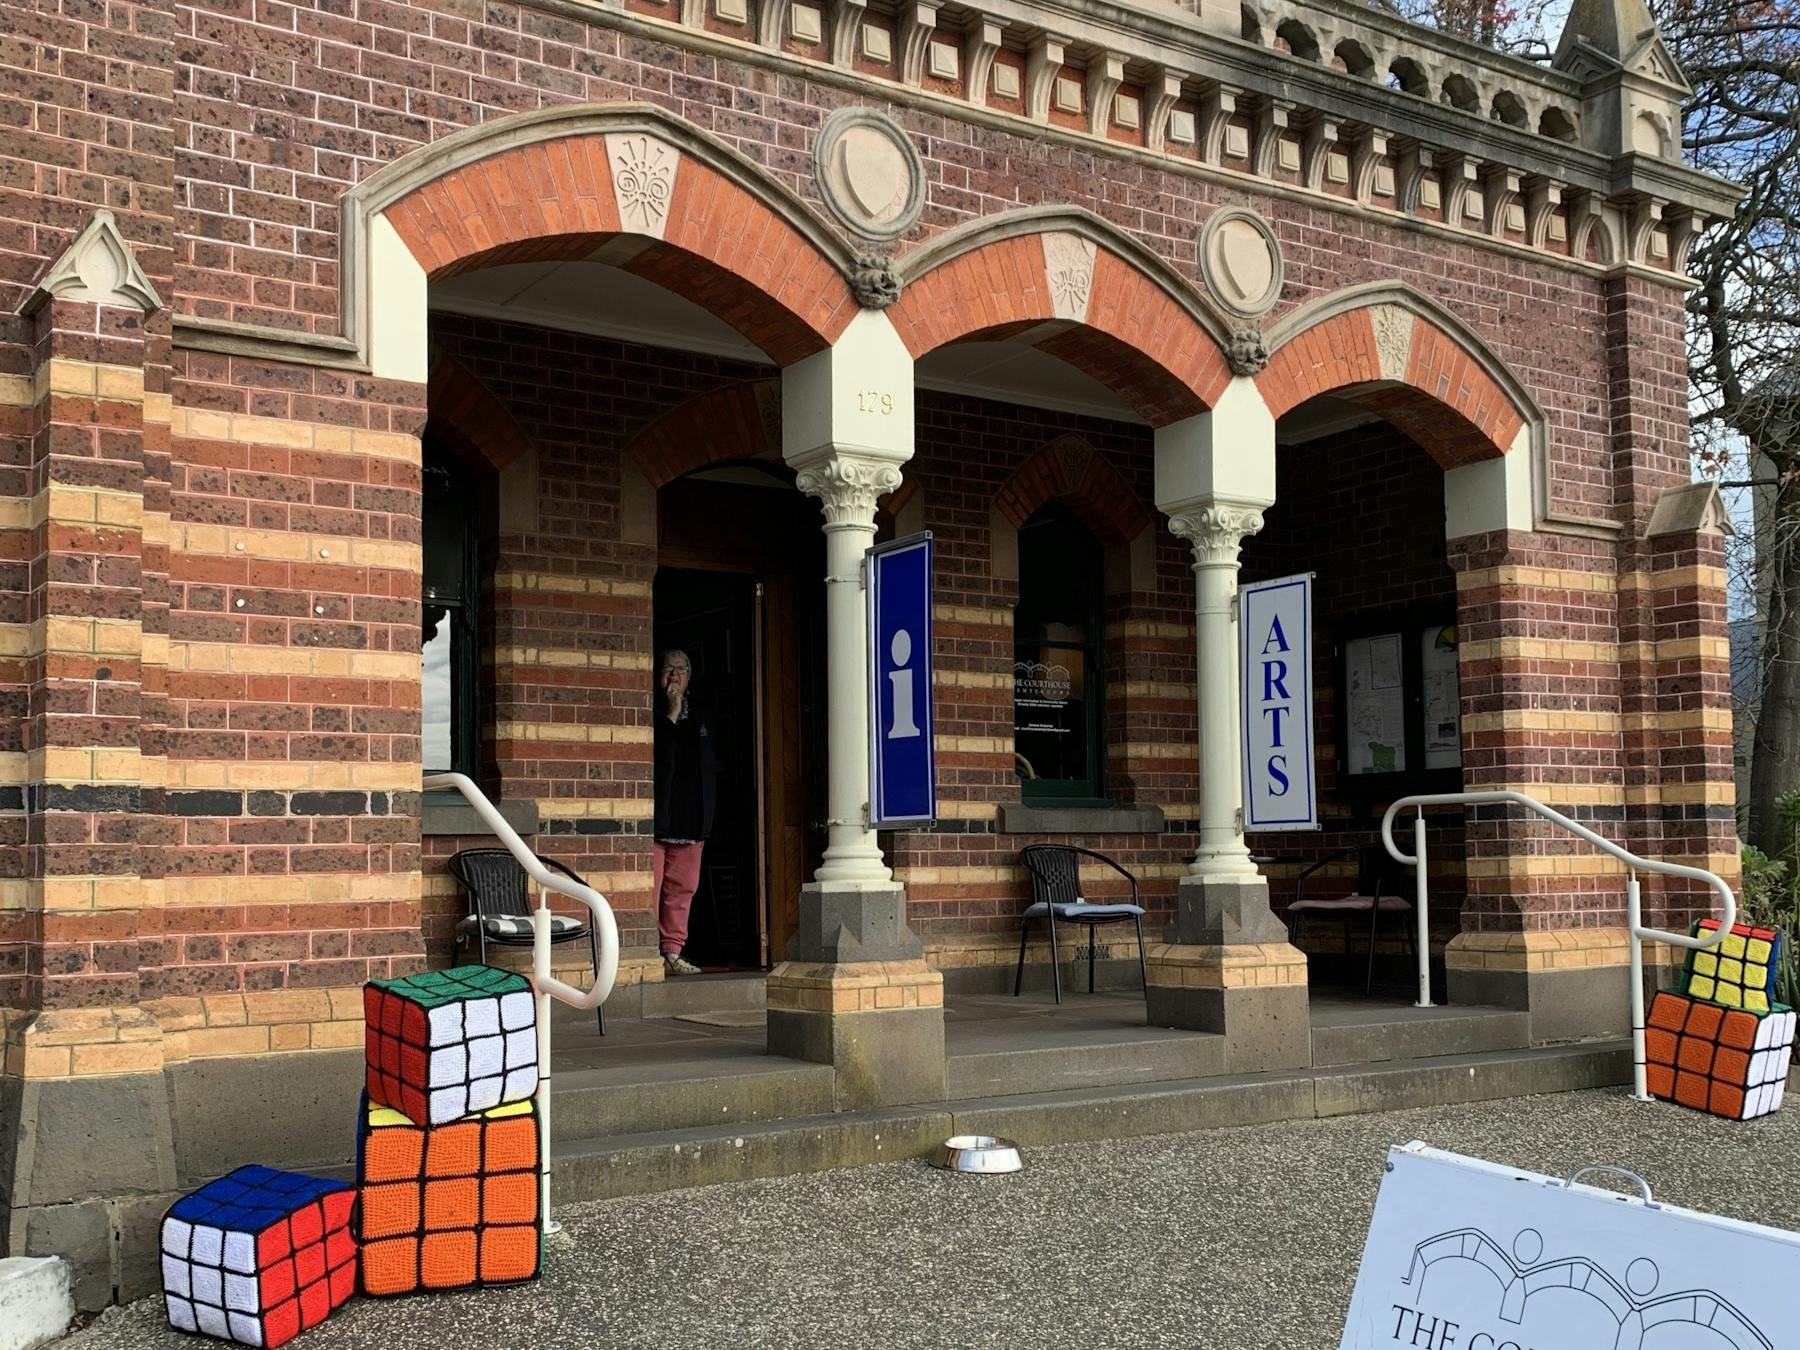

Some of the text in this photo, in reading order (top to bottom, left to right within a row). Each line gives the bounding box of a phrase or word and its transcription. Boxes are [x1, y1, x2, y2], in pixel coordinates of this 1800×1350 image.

[888, 629, 920, 739] i
[1024, 679, 1072, 689] COURTHOUSE
[1261, 612, 1292, 797] ARTS
[1391, 1304, 1460, 1350] THE
